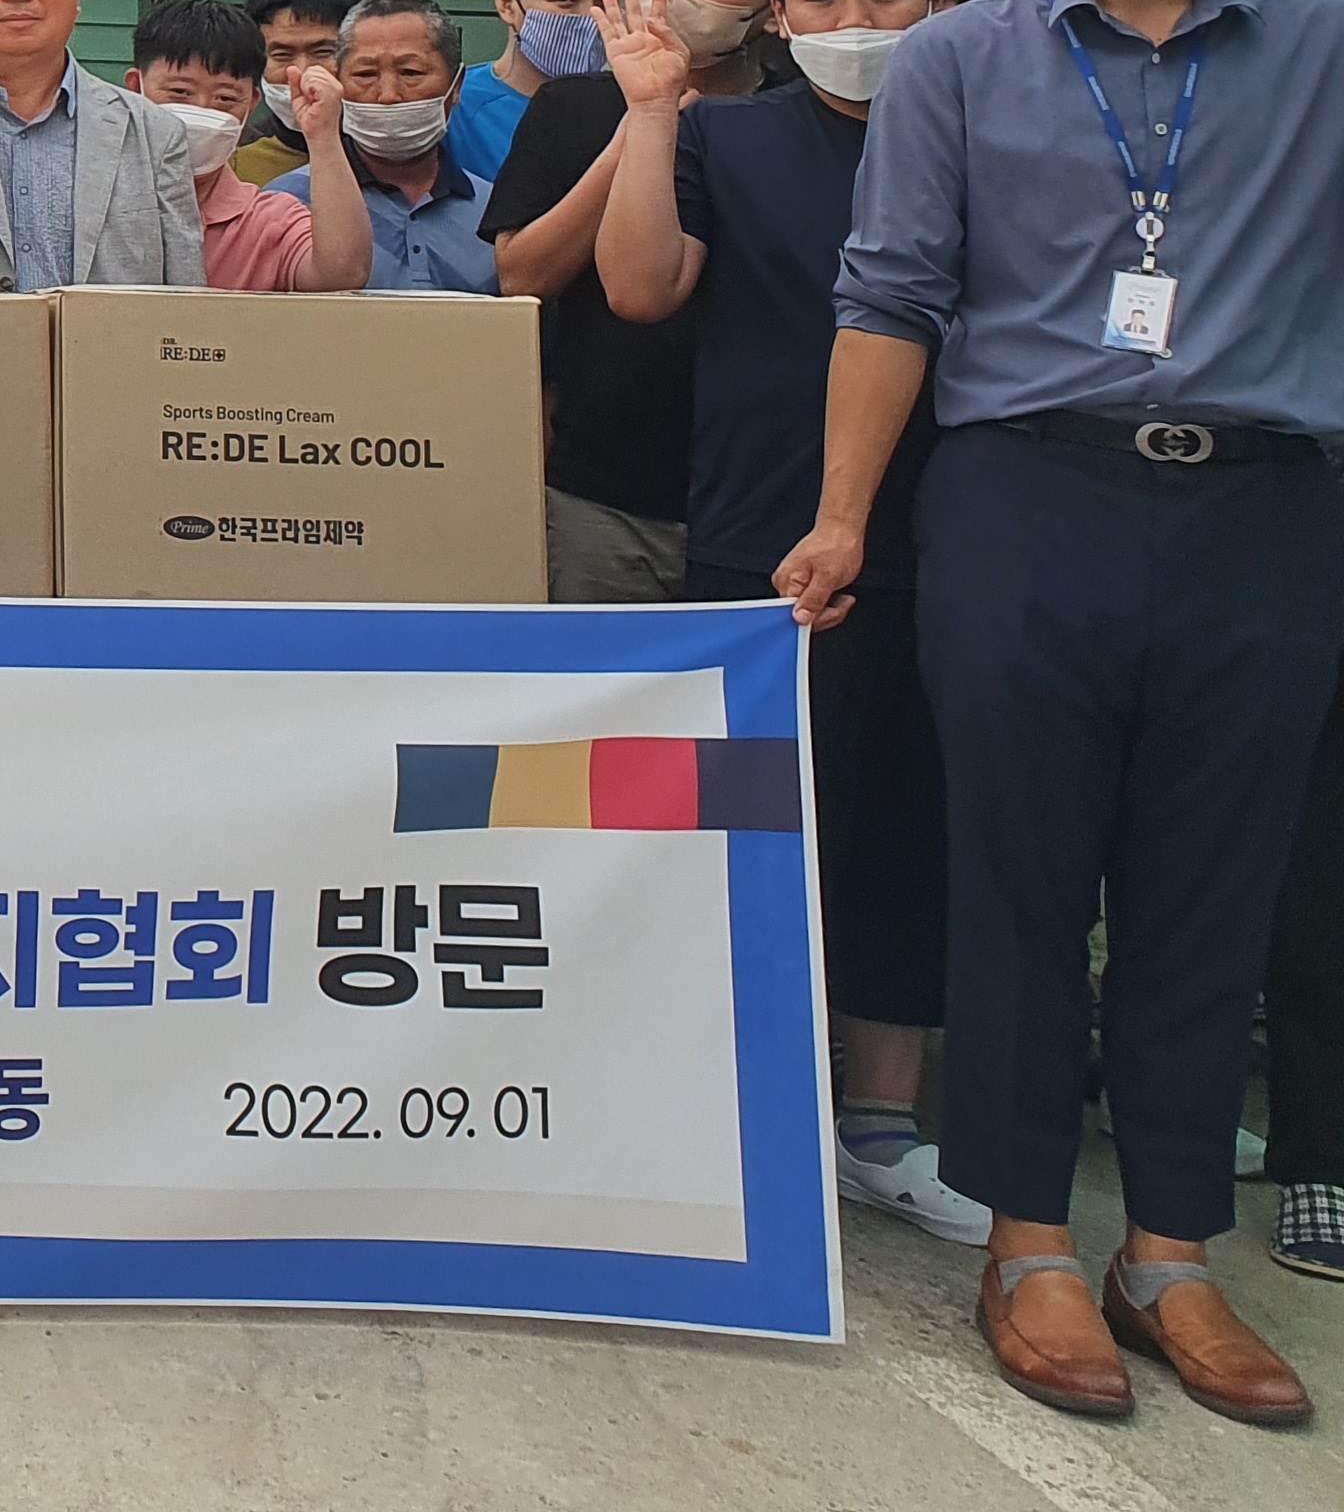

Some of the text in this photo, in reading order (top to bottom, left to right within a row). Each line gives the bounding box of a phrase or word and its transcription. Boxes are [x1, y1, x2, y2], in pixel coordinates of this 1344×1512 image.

[162, 404, 335, 425] Sports Boosting Cream
[161, 431, 445, 469] RE:DE Lax COOL
[169, 516, 365, 546] Prime 한국프라임제약
[316, 883, 551, 1012] 방문
[223, 1082, 551, 1141] 2022. 09. 01
